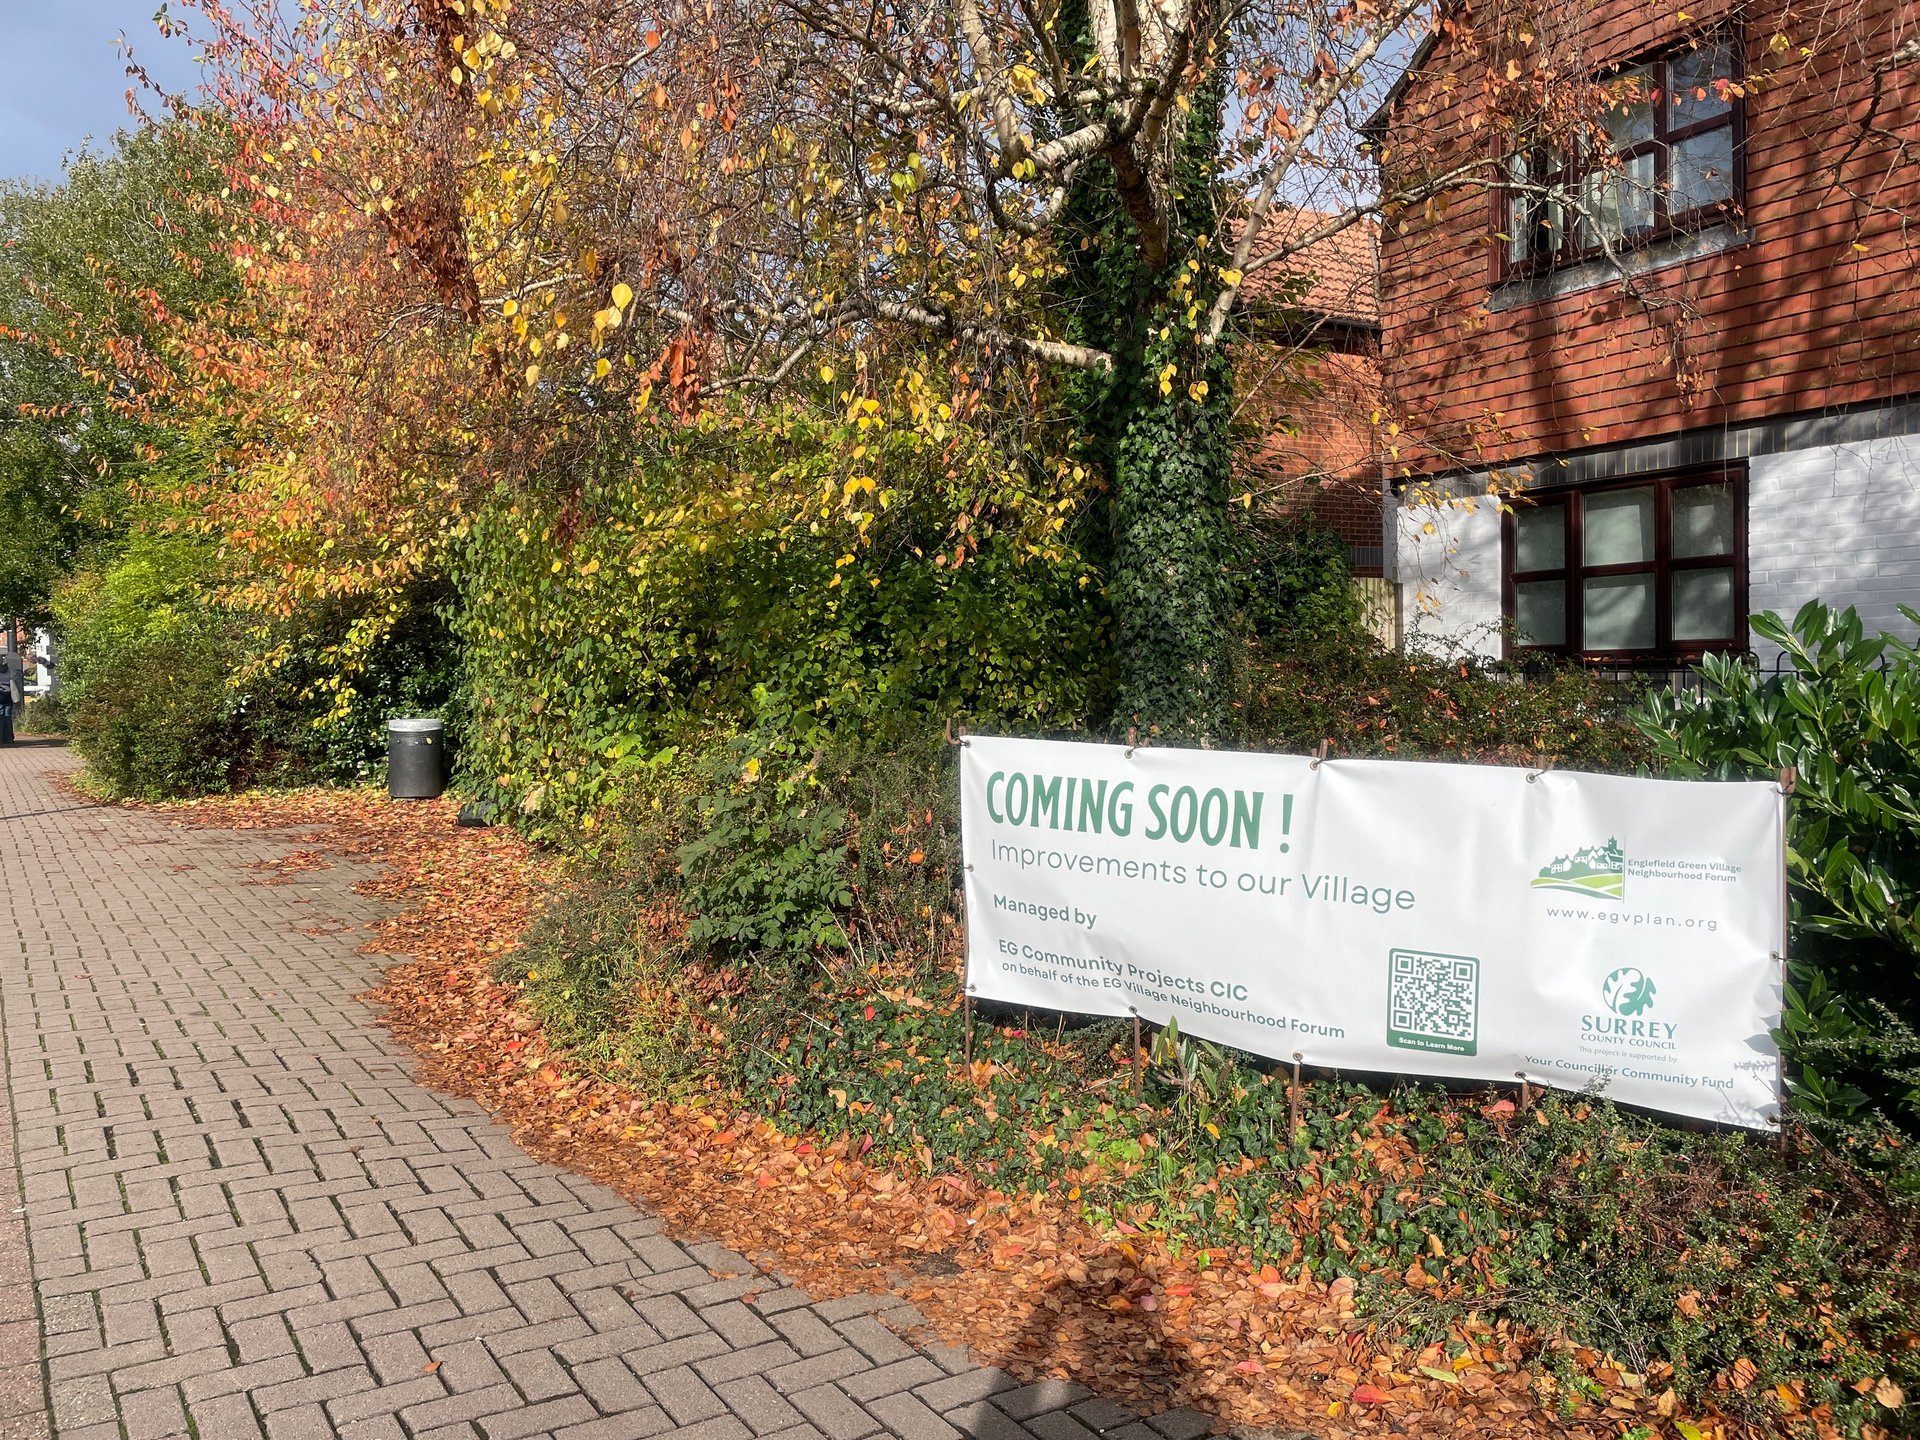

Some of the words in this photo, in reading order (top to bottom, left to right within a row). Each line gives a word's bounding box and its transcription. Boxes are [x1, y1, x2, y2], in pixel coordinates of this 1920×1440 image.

[986, 771, 1134, 837] COMING
[1145, 784, 1264, 849] SOON
[1279, 794, 1294, 853] !
[991, 839, 1187, 884] Improvements
[1196, 865, 1228, 889] to
[1237, 870, 1291, 896] our
[1302, 874, 1416, 914] Village
[1628, 859, 1675, 869] Englefield
[1677, 860, 1707, 871] Green
[1708, 863, 1741, 874] Village
[1628, 868, 1703, 881] Neighbourhood
[1704, 873, 1737, 882] Forum
[993, 894, 1070, 923] Managed
[1074, 908, 1097, 929] by
[1547, 907, 1718, 931] www.egvplan.org
[999, 940, 1018, 956] EG
[1022, 945, 1123, 976] Community
[1127, 963, 1205, 993] Projects
[1210, 981, 1248, 1001] CIC
[1002, 963, 1016, 972] on
[1020, 963, 1057, 982] behalf
[1061, 971, 1073, 983] of
[1075, 974, 1099, 988] the
[1103, 977, 1122, 989] EG
[1124, 981, 1168, 1002] Village
[1171, 995, 1286, 1029] Neighbourhood
[1291, 1019, 1345, 1038] Forum
[1581, 1015, 1678, 1040] SURREY
[1398, 1037, 1416, 1045] Scan
[1417, 1039, 1425, 1047] to
[1426, 1041, 1446, 1049] Learn
[1447, 1043, 1465, 1052] More
[1581, 1032, 1626, 1046] COUNTY
[1629, 1038, 1676, 1050] COUNCIL
[1579, 1046, 1592, 1054] This
[1594, 1048, 1619, 1057] project
[1629, 1053, 1666, 1062] supported
[1669, 1055, 1677, 1065] by
[1525, 1055, 1552, 1067] Your
[1555, 1058, 1618, 1075] Councillor
[1622, 1066, 1699, 1089] Community
[1702, 1075, 1734, 1089] Fund
